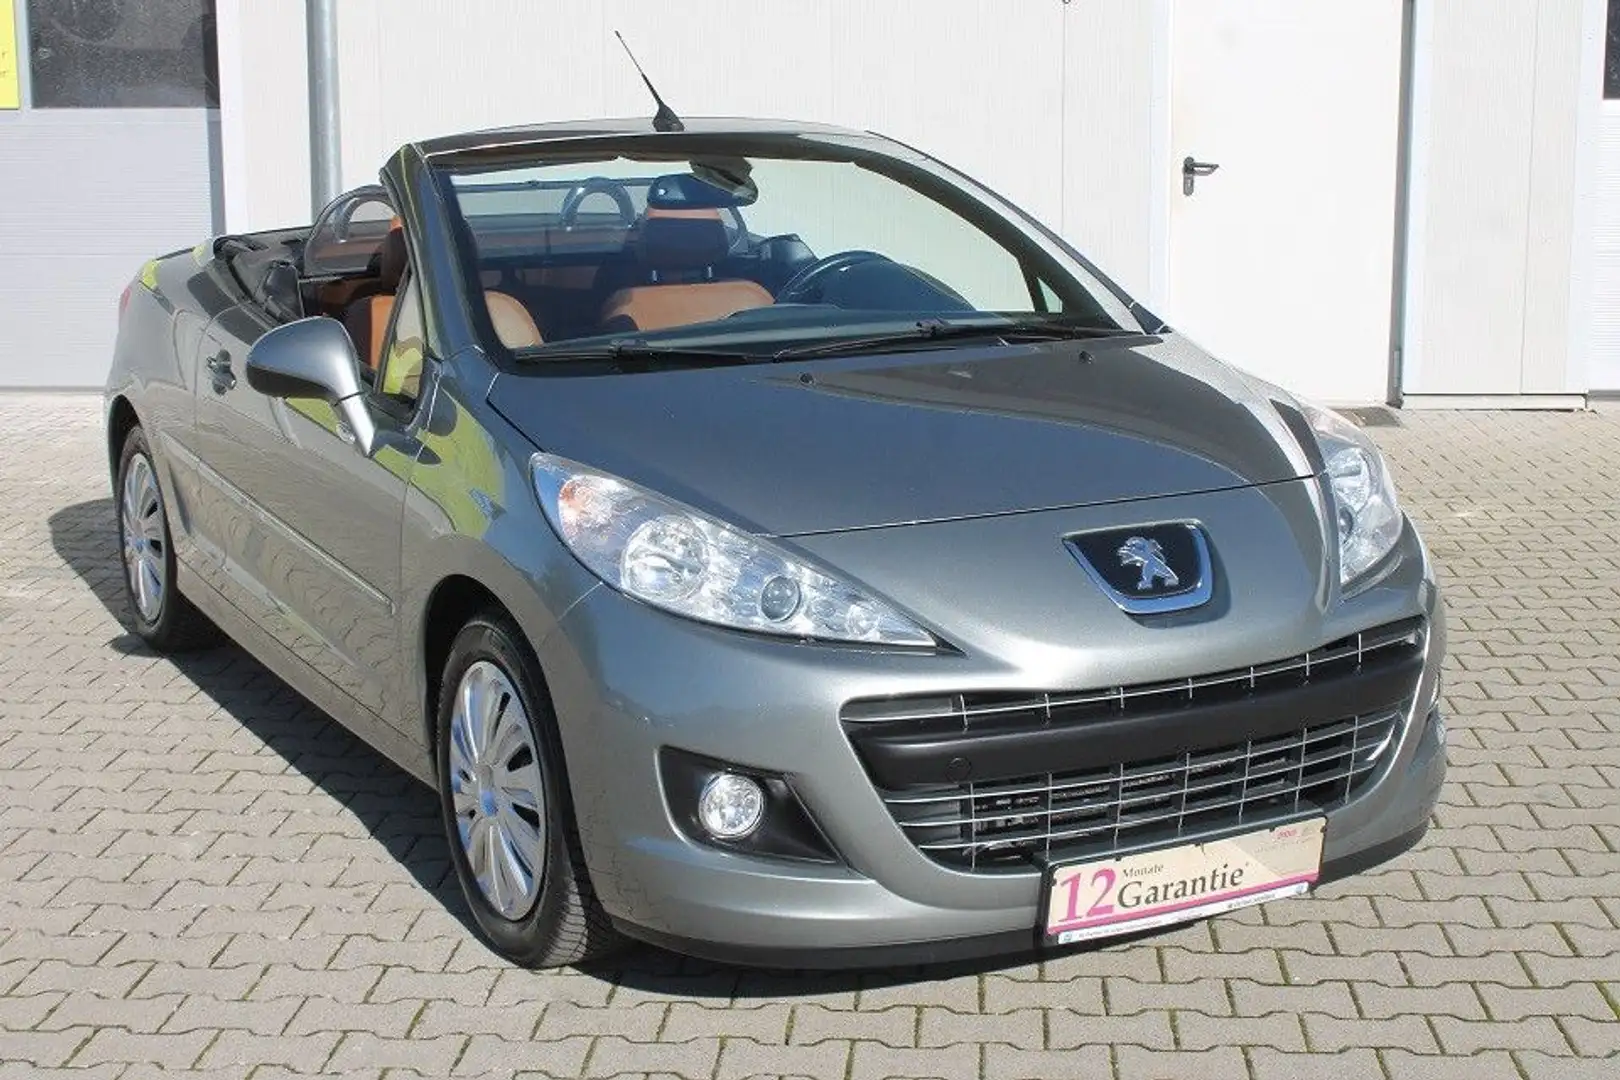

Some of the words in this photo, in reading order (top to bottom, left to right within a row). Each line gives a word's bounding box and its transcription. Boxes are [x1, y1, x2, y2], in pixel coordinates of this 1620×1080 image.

[1118, 863, 1245, 909] Garantie
[1123, 863, 1164, 879] Monate
[1058, 868, 1117, 923] 12
